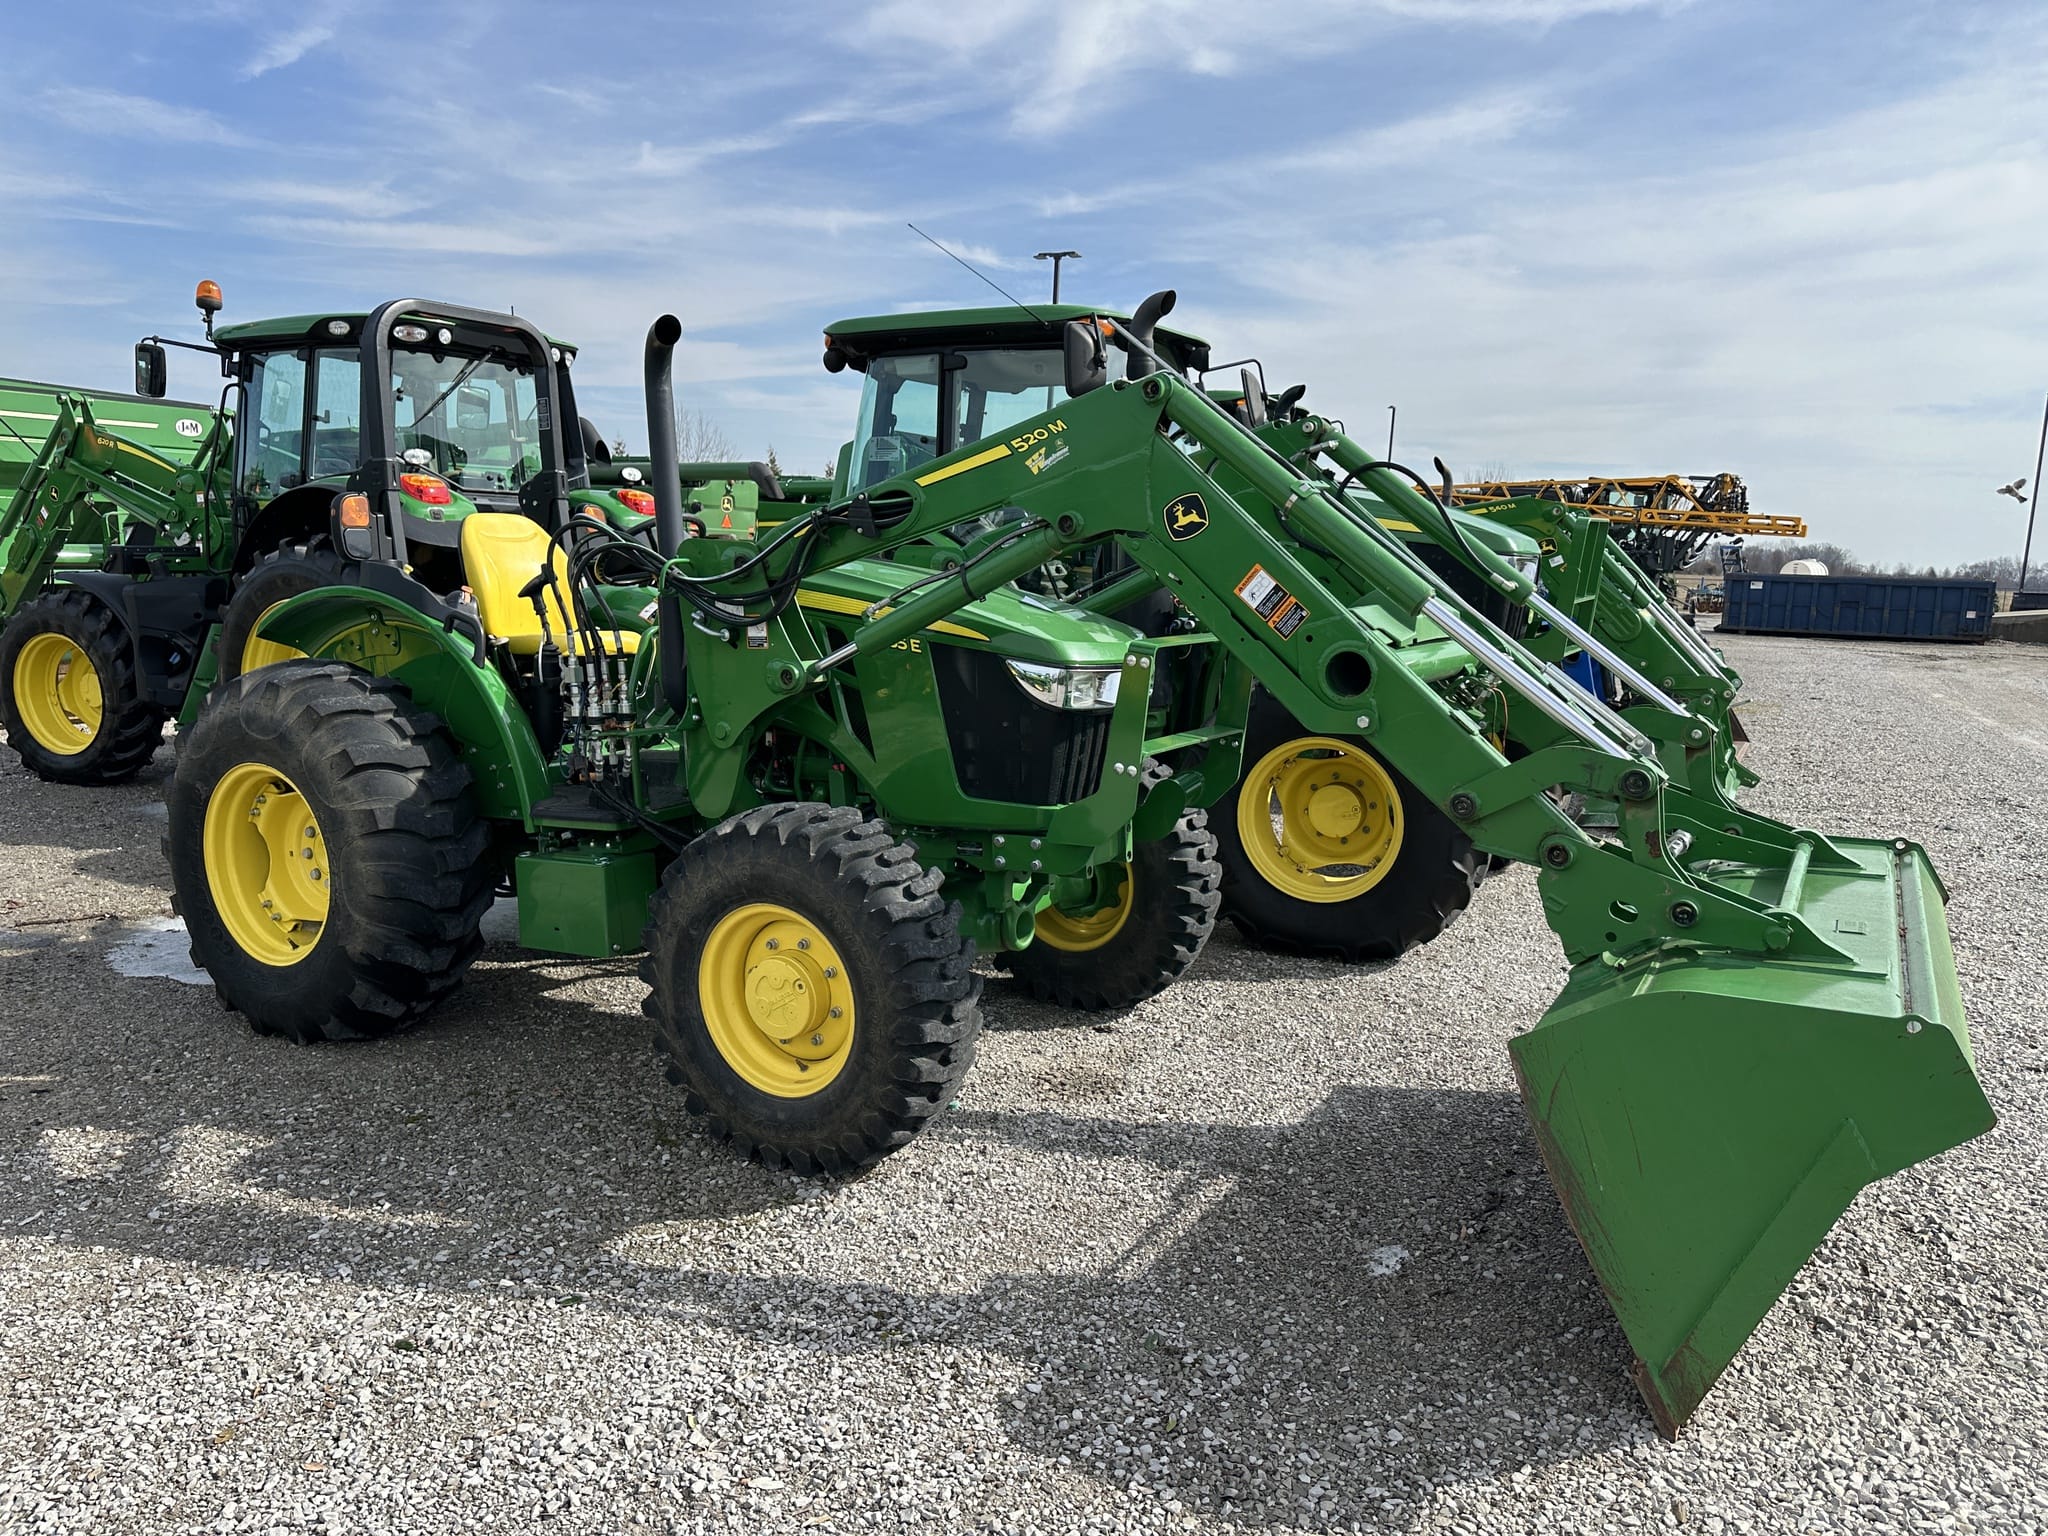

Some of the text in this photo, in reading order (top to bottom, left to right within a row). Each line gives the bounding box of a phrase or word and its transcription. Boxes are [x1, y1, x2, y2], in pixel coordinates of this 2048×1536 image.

[179, 421, 199, 434] J&M
[97, 437, 109, 446] 620
[1010, 419, 1068, 452] 520 M
[1488, 504, 1507, 512] 540
[909, 638, 922, 653] E
